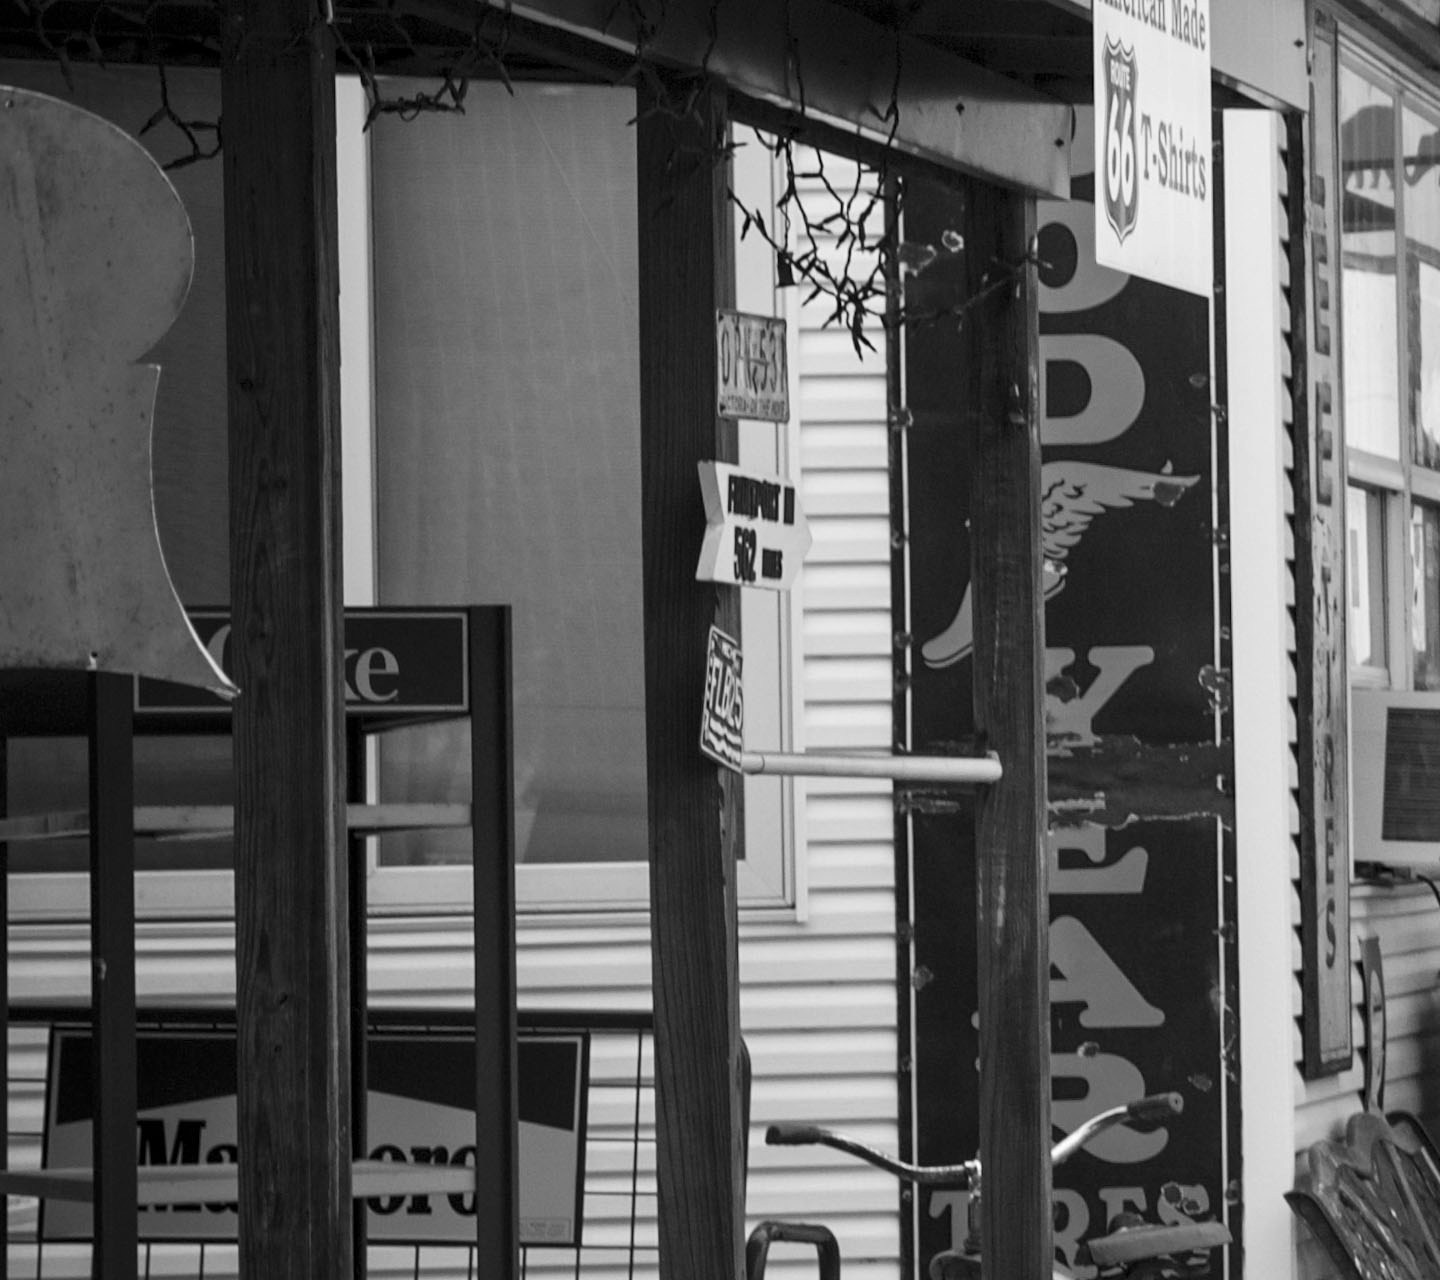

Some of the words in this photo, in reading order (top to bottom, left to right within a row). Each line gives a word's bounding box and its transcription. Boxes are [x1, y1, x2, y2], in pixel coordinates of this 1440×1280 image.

[1110, 57, 1131, 92] ROUTE
[1107, 97, 1133, 209] 66
[1141, 111, 1207, 203] T-Shirts
